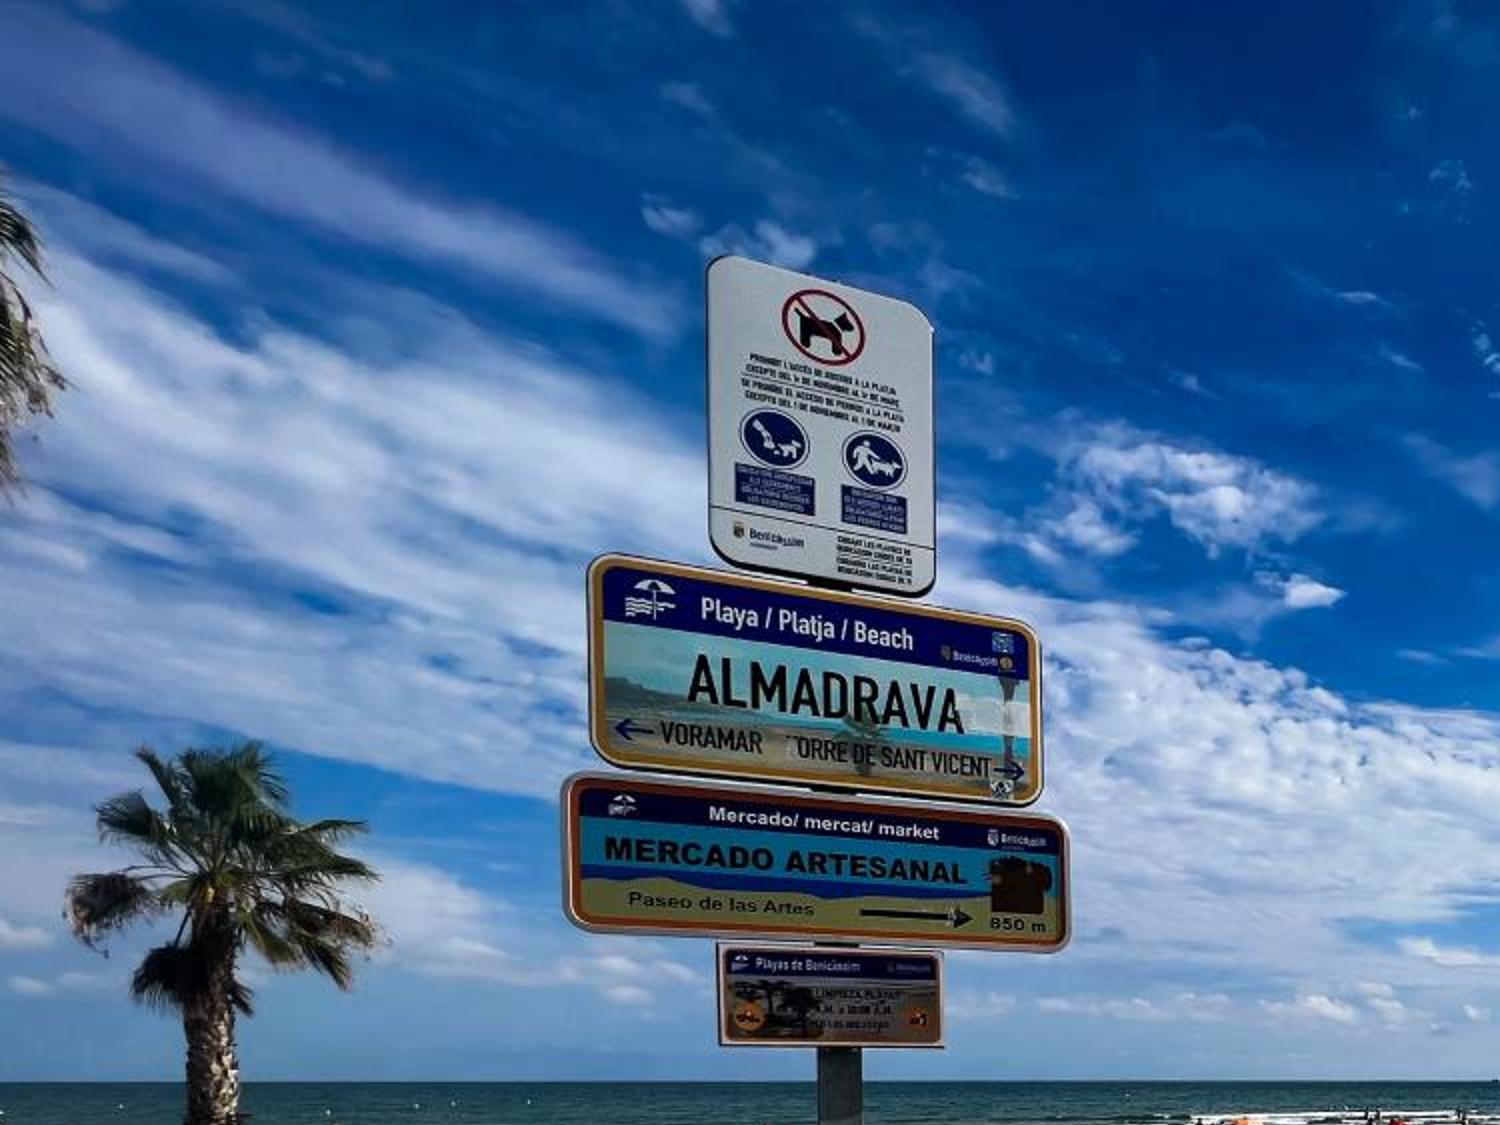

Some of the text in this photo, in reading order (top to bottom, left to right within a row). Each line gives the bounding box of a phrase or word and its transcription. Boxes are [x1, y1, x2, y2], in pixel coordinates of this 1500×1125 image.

[701, 596, 914, 650] Playa / Platja / Beach
[687, 652, 965, 735] ALMADRAVA
[661, 720, 763, 754] VORAMAR
[853, 743, 875, 766] DE
[881, 745, 929, 771] SANT
[931, 752, 993, 778] VICENT
[708, 804, 940, 841] Mercado/ mercat/ market
[604, 836, 968, 886] MERCADO ARTESANAL
[628, 890, 816, 917] Paseo de las Artes
[990, 917, 1047, 933] 850 m
[755, 957, 789, 972] Playas
[791, 959, 803, 971] de
